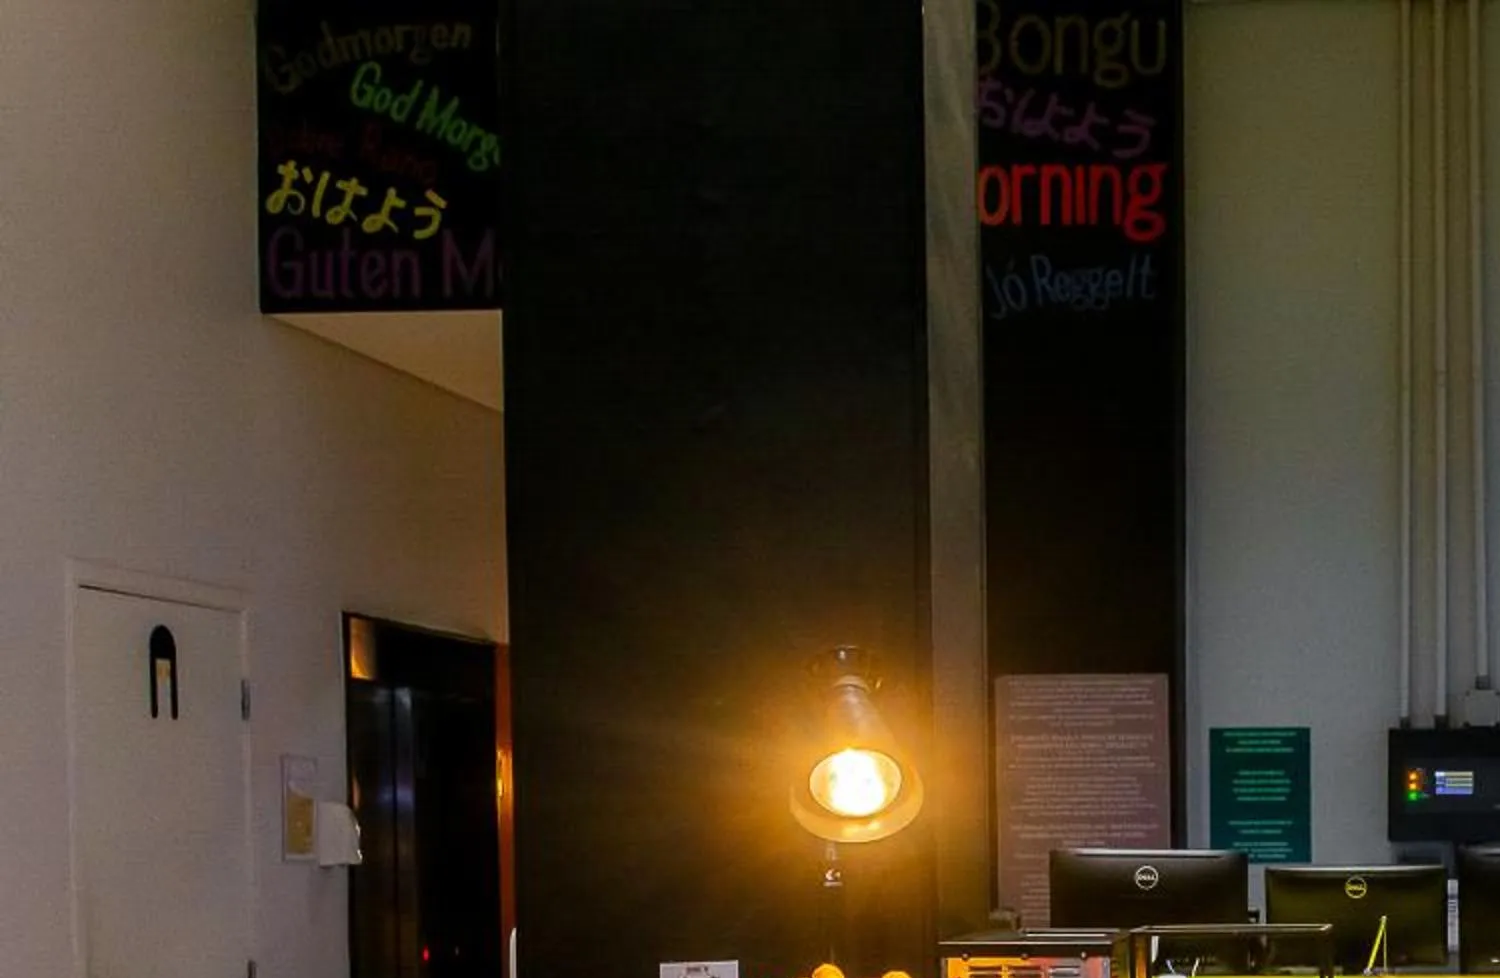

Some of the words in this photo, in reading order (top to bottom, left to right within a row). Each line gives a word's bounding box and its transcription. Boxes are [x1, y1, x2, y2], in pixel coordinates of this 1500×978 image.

[350, 60, 424, 124] God
[264, 158, 448, 240] おはよう
[977, 161, 1172, 243] orning
[266, 225, 422, 301] Guten
